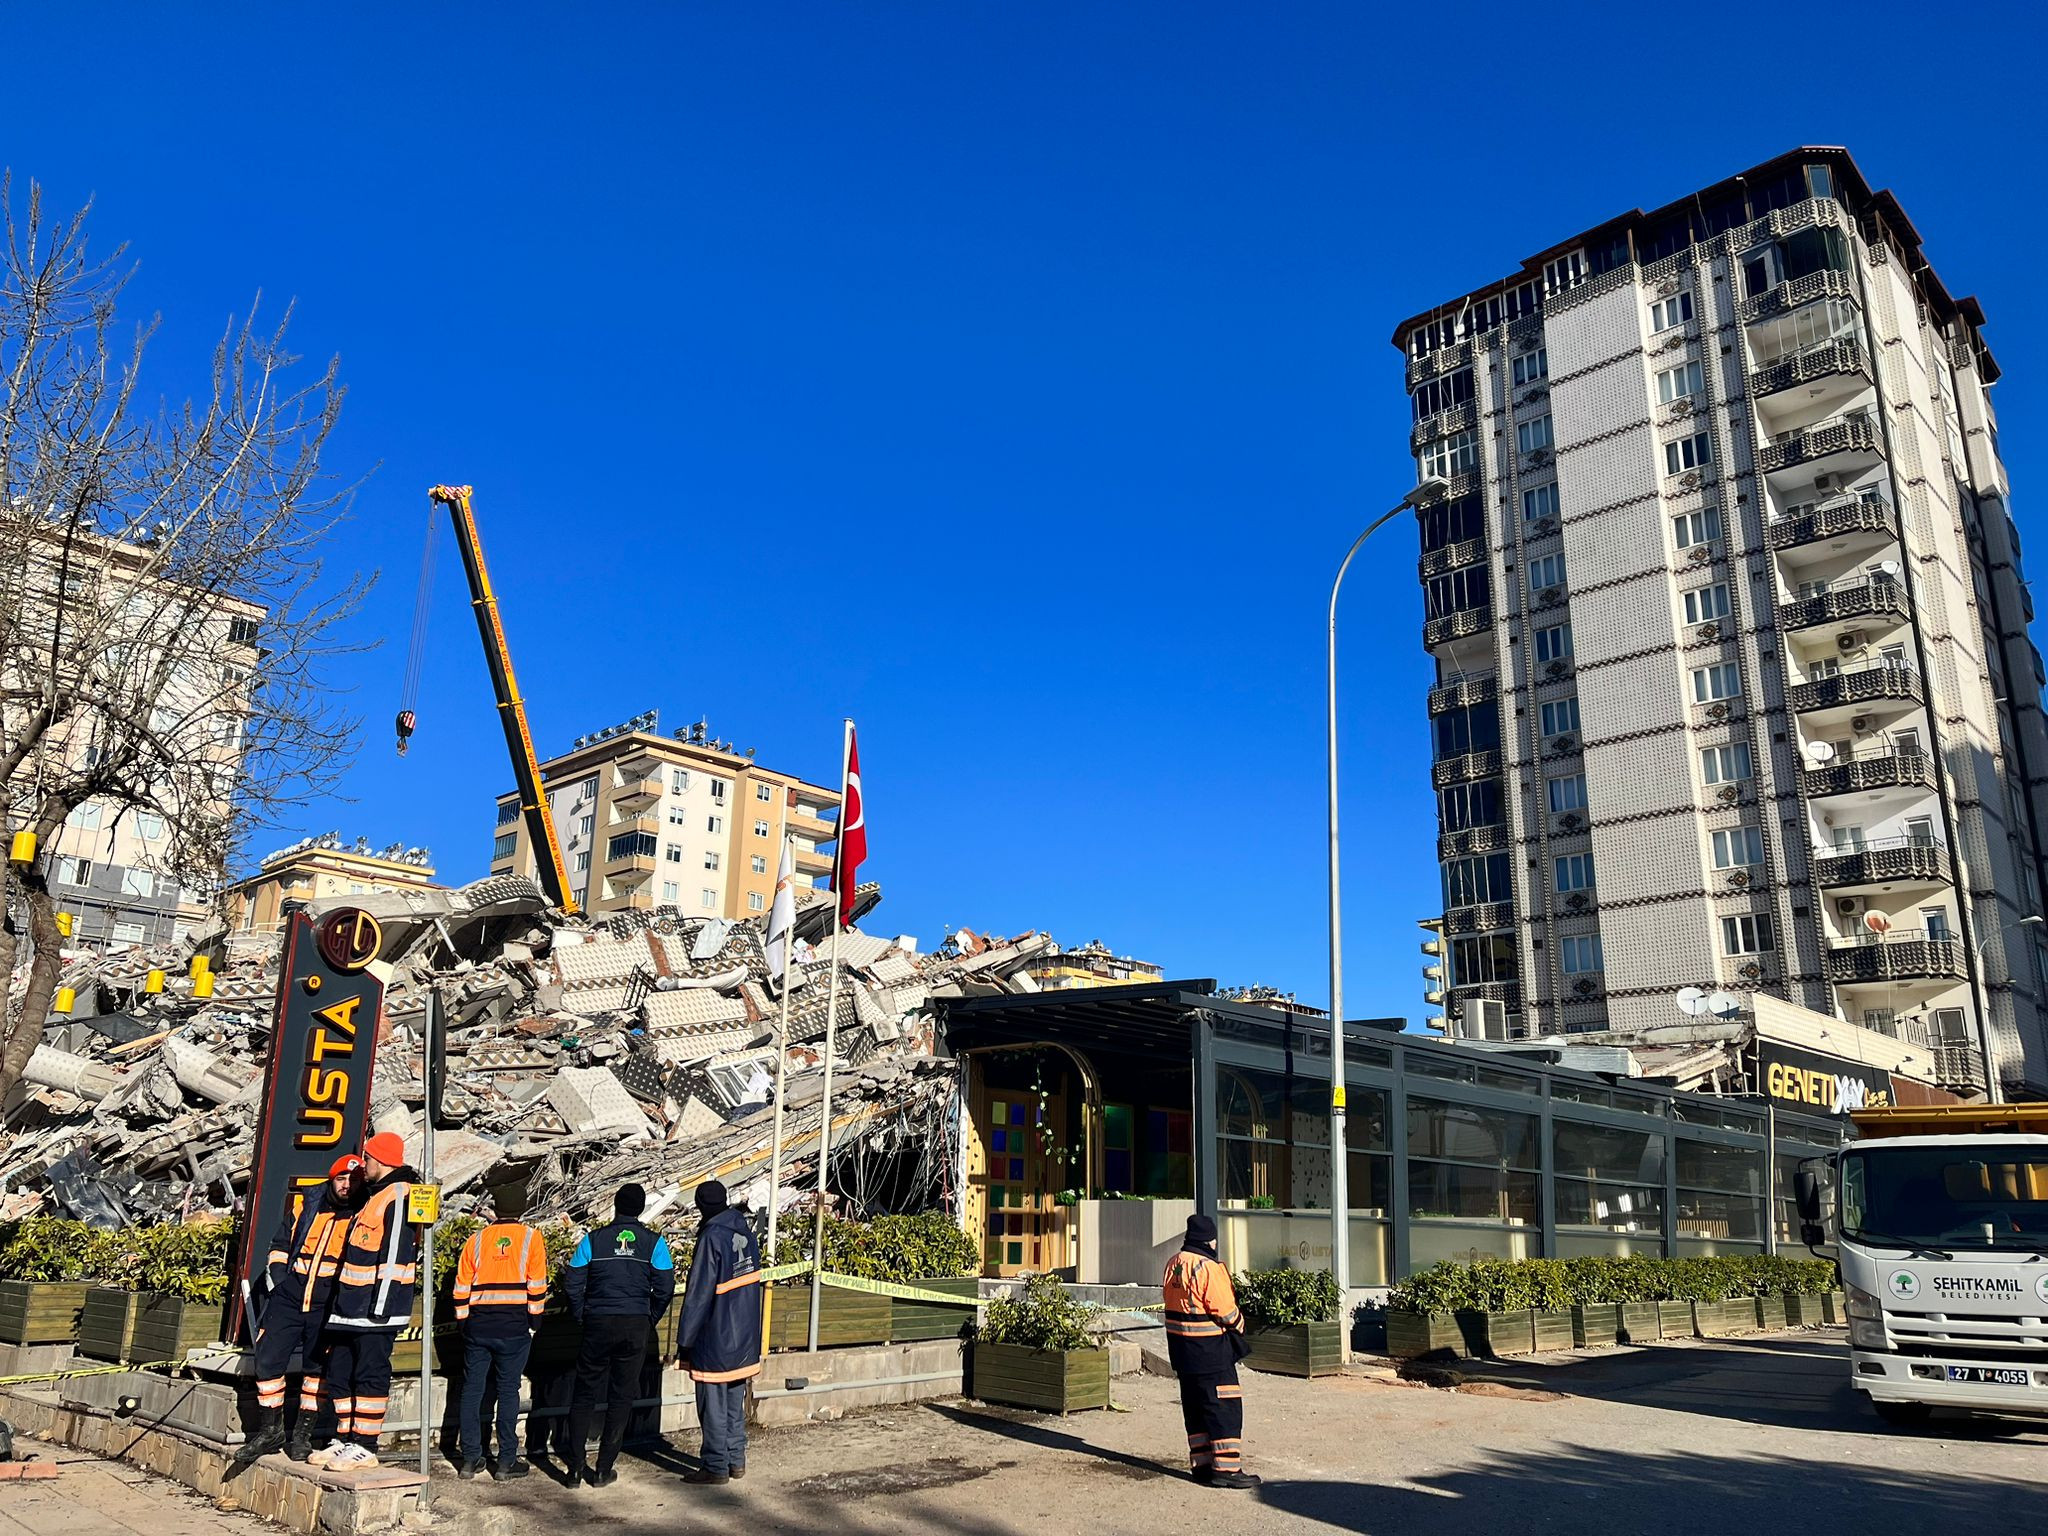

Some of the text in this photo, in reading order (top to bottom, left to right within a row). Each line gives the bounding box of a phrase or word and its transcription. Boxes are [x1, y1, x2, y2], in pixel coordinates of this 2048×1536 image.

[300, 996, 360, 1144] USTA
[1954, 1368, 1969, 1380] 27
[1994, 1370, 2026, 1384] 4055
